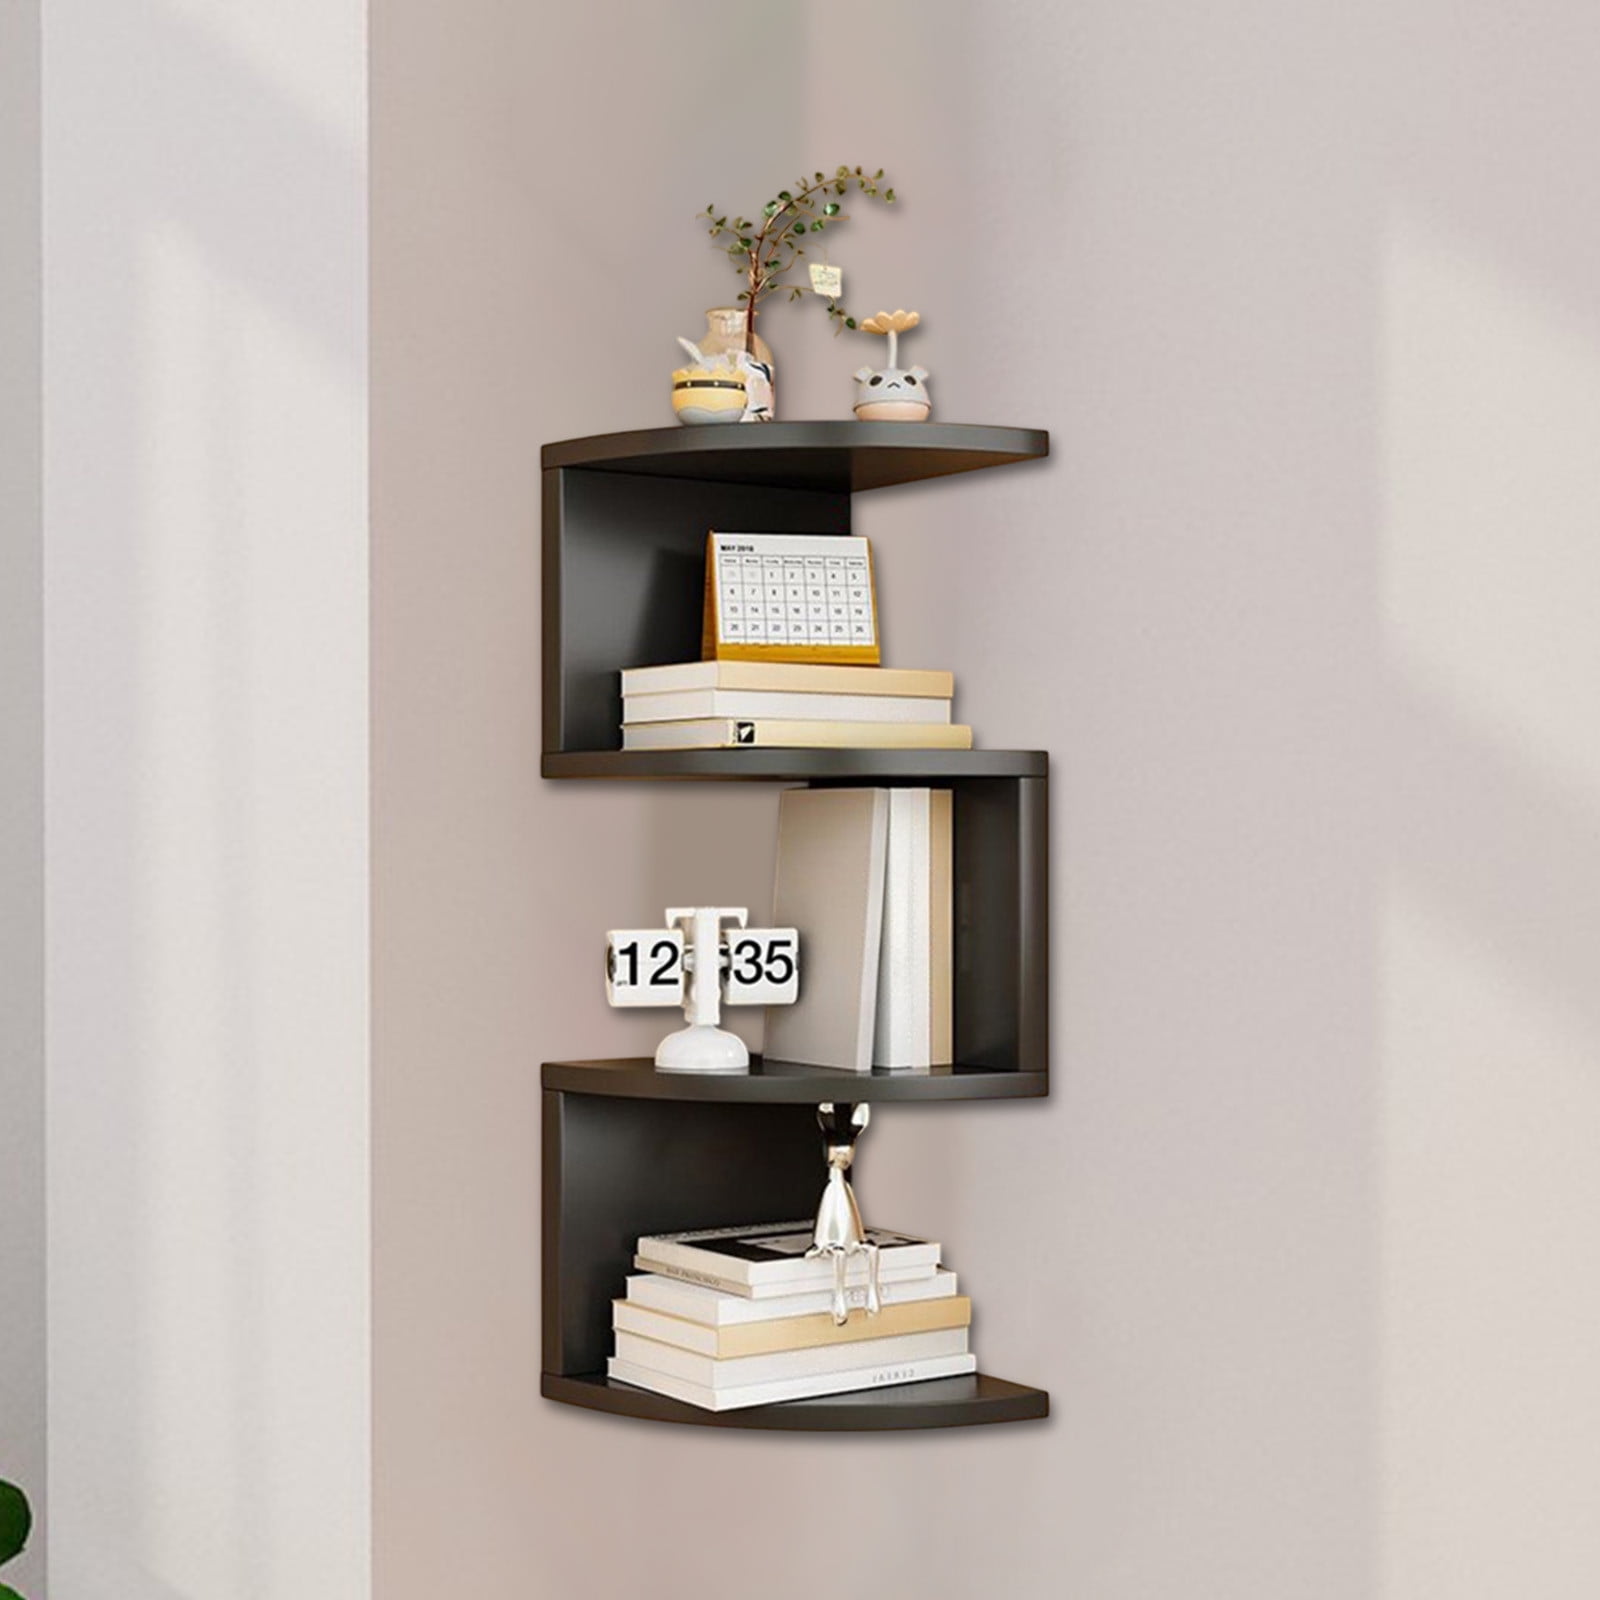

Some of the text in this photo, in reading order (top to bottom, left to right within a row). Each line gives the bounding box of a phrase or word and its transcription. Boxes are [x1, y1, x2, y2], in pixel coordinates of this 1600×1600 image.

[720, 543, 736, 552] MAY
[831, 572, 836, 580] 4
[618, 940, 794, 986] 12 35
